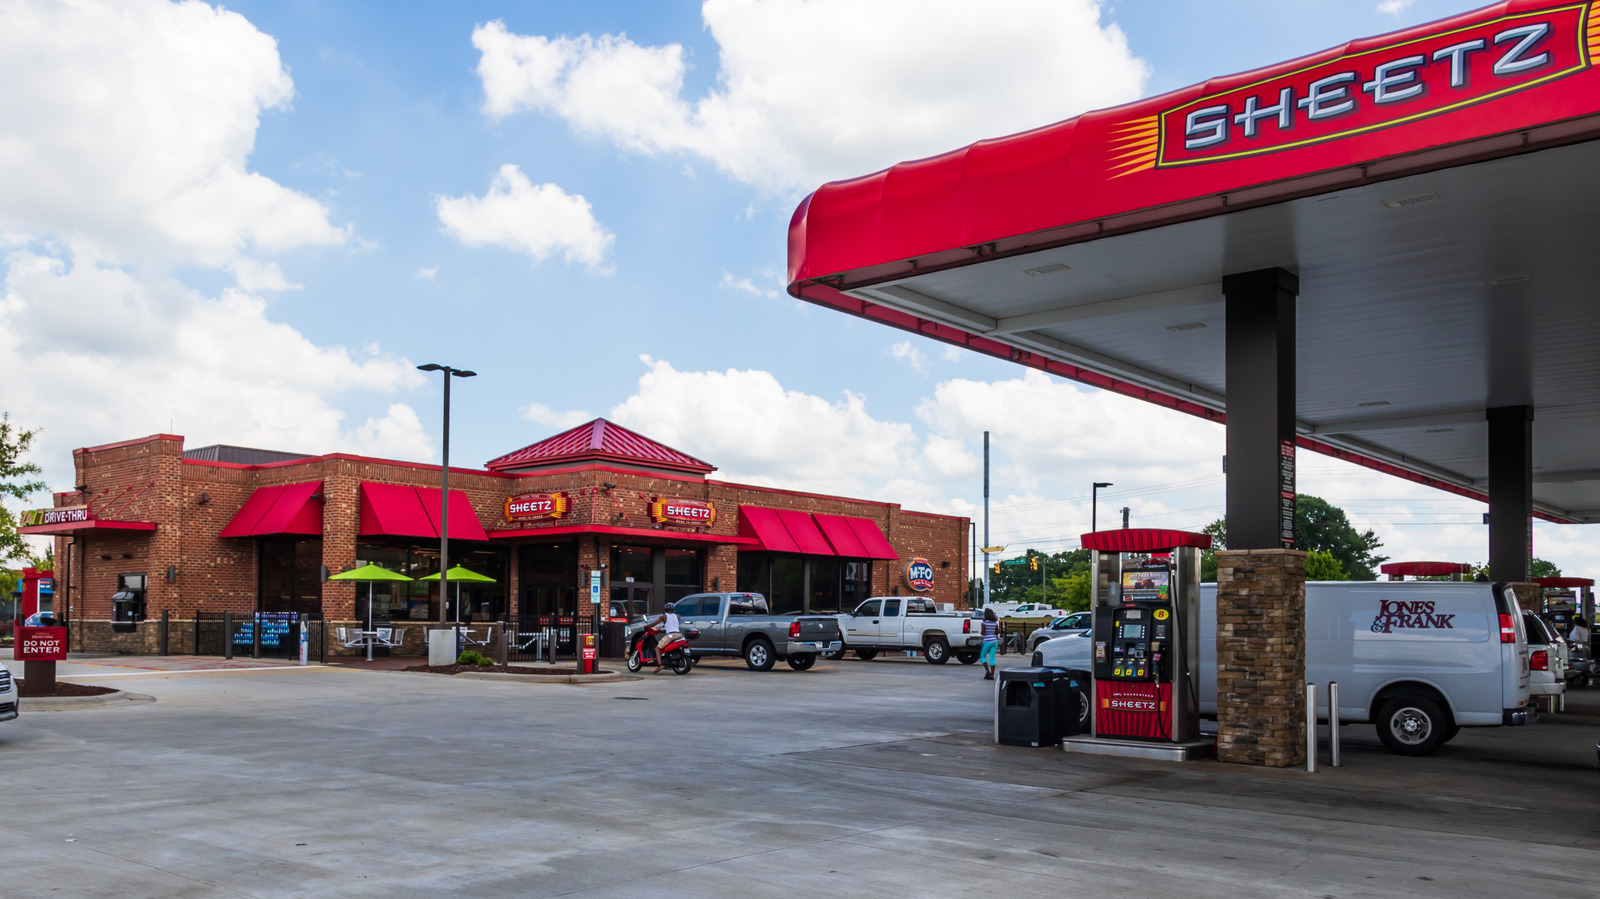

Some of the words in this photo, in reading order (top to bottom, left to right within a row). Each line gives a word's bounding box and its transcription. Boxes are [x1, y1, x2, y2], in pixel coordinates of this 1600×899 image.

[1185, 22, 1551, 150] SHEETZ
[510, 500, 552, 513] SHEETZ
[667, 505, 710, 519] SHEETZ
[1158, 610, 1165, 618] 8
[1375, 599, 1436, 619] JONES
[1381, 613, 1456, 634] FRANK
[23, 646, 60, 654] ENTER
[1111, 700, 1156, 709] SHEETZ
